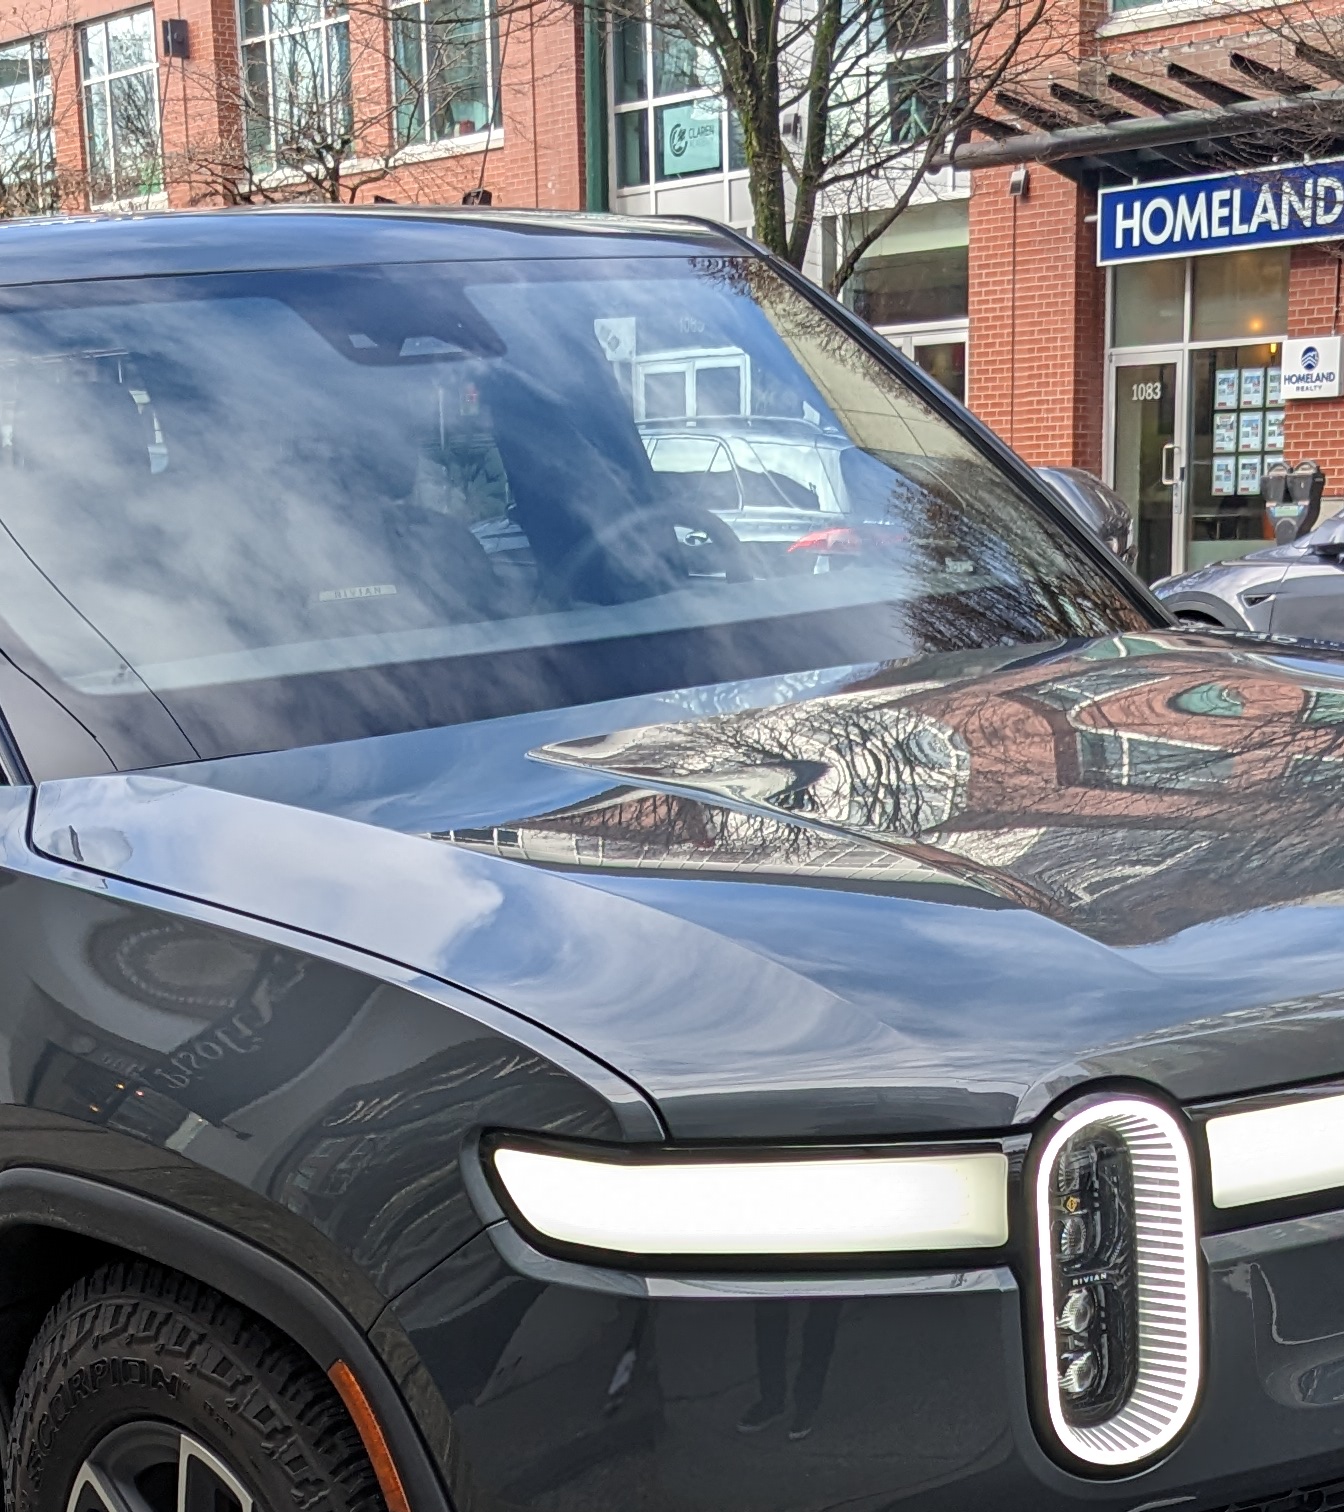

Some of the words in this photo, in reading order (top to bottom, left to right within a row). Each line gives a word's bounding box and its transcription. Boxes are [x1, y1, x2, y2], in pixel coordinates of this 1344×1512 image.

[1115, 176, 1344, 249] HOMELAND
[1283, 371, 1336, 386] HOMELAND
[1131, 382, 1162, 401] 1083
[1295, 384, 1323, 392] REALTY
[335, 586, 381, 599] RIVIAN
[1072, 1272, 1107, 1286] RIVIAN
